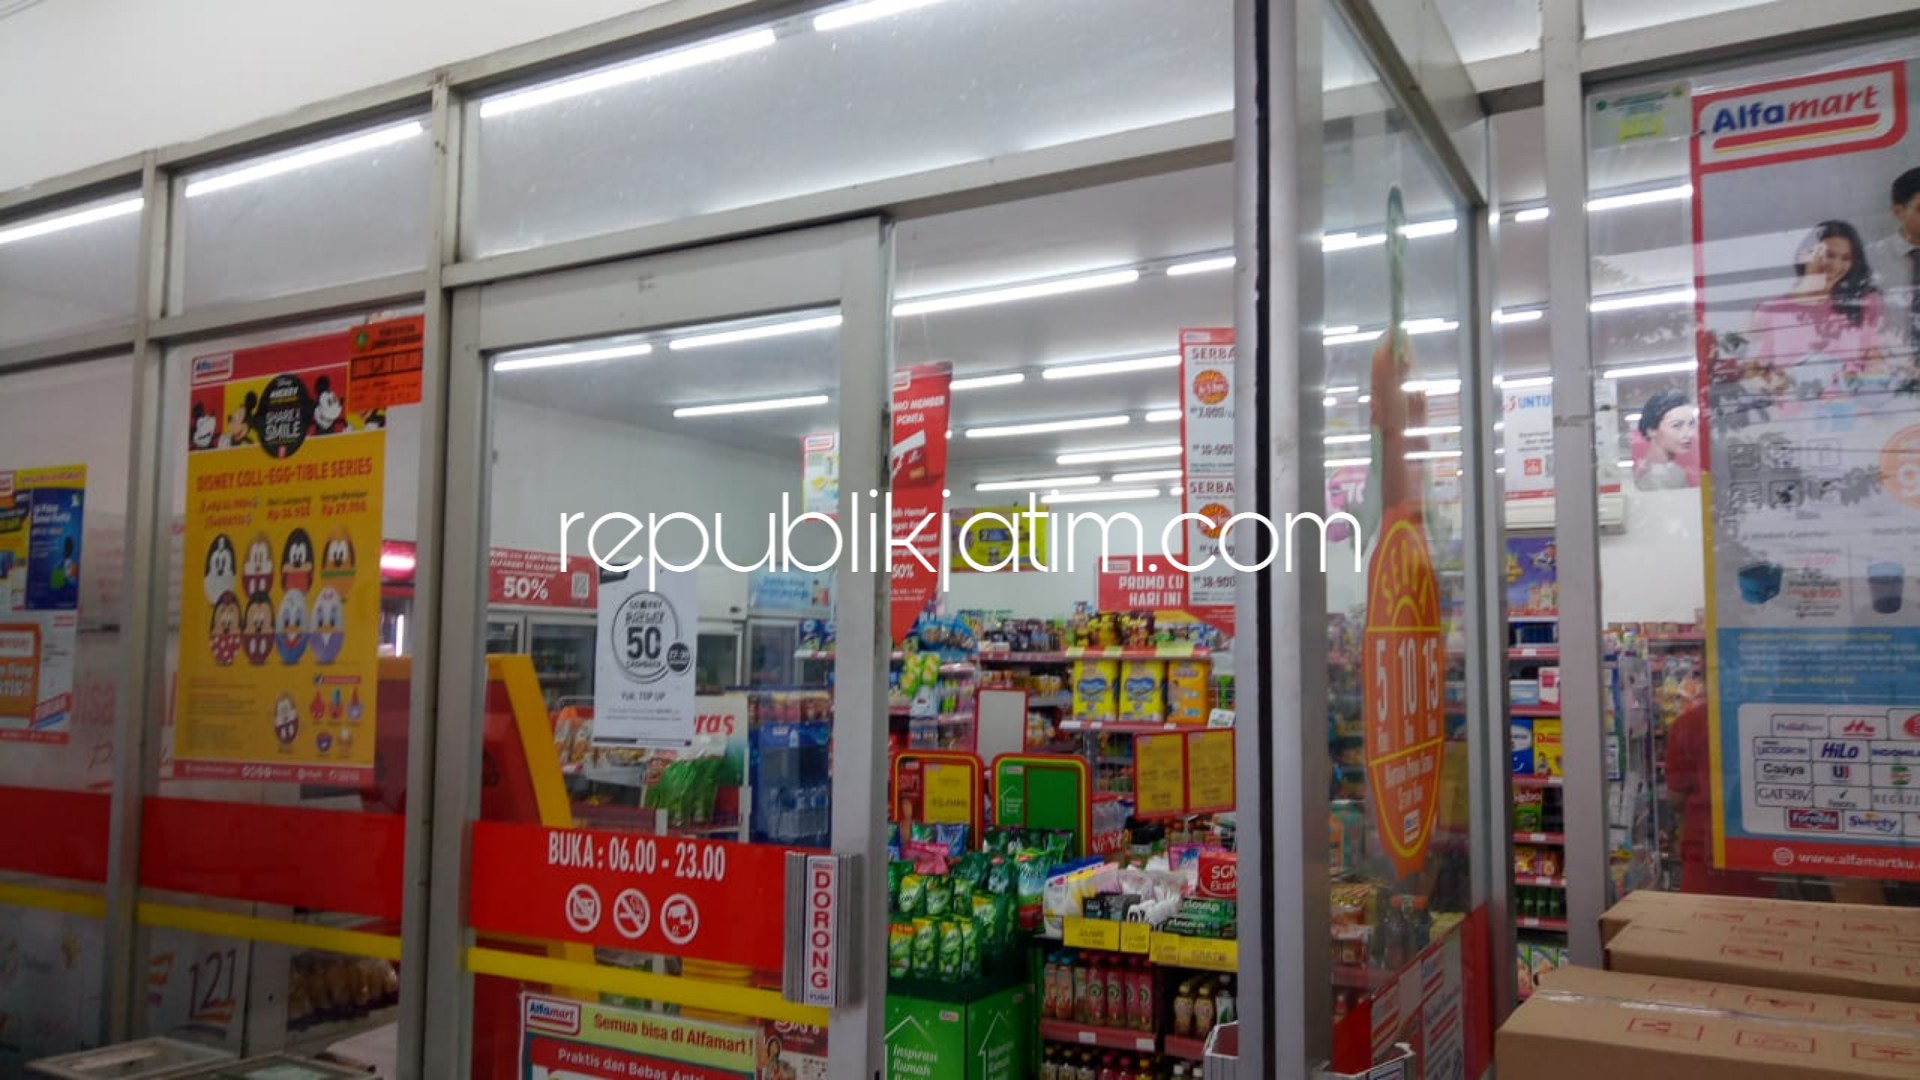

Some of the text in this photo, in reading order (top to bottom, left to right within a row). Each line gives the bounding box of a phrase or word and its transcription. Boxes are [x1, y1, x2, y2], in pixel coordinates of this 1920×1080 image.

[1712, 84, 1880, 134] Alfamart
[264, 421, 301, 441] SMILE
[197, 474, 234, 492] DISNEY
[331, 457, 373, 477] SERIES
[1190, 481, 1235, 494] SERBA
[503, 576, 549, 601] 50%
[1118, 576, 1164, 590] PROMO
[1129, 592, 1160, 606] HARI
[1164, 591, 1182, 606] INI
[627, 626, 662, 660] 50
[1376, 637, 1440, 722] 5 10 15
[548, 831, 594, 868] BUKA
[608, 836, 656, 874] 06.00
[675, 842, 726, 882] 23.00
[1797, 852, 1920, 872] www.alfamartku.
[811, 870, 832, 990] DORONG
[529, 1001, 575, 1022] Alfamart
[594, 1013, 638, 1035] Semua
[641, 1021, 667, 1041] bisa
[671, 1026, 684, 1043] di
[686, 1030, 745, 1055] Alfamart
[558, 1049, 599, 1067] Praktis
[602, 1057, 625, 1072] dan
[629, 1061, 668, 1080] Bebas
